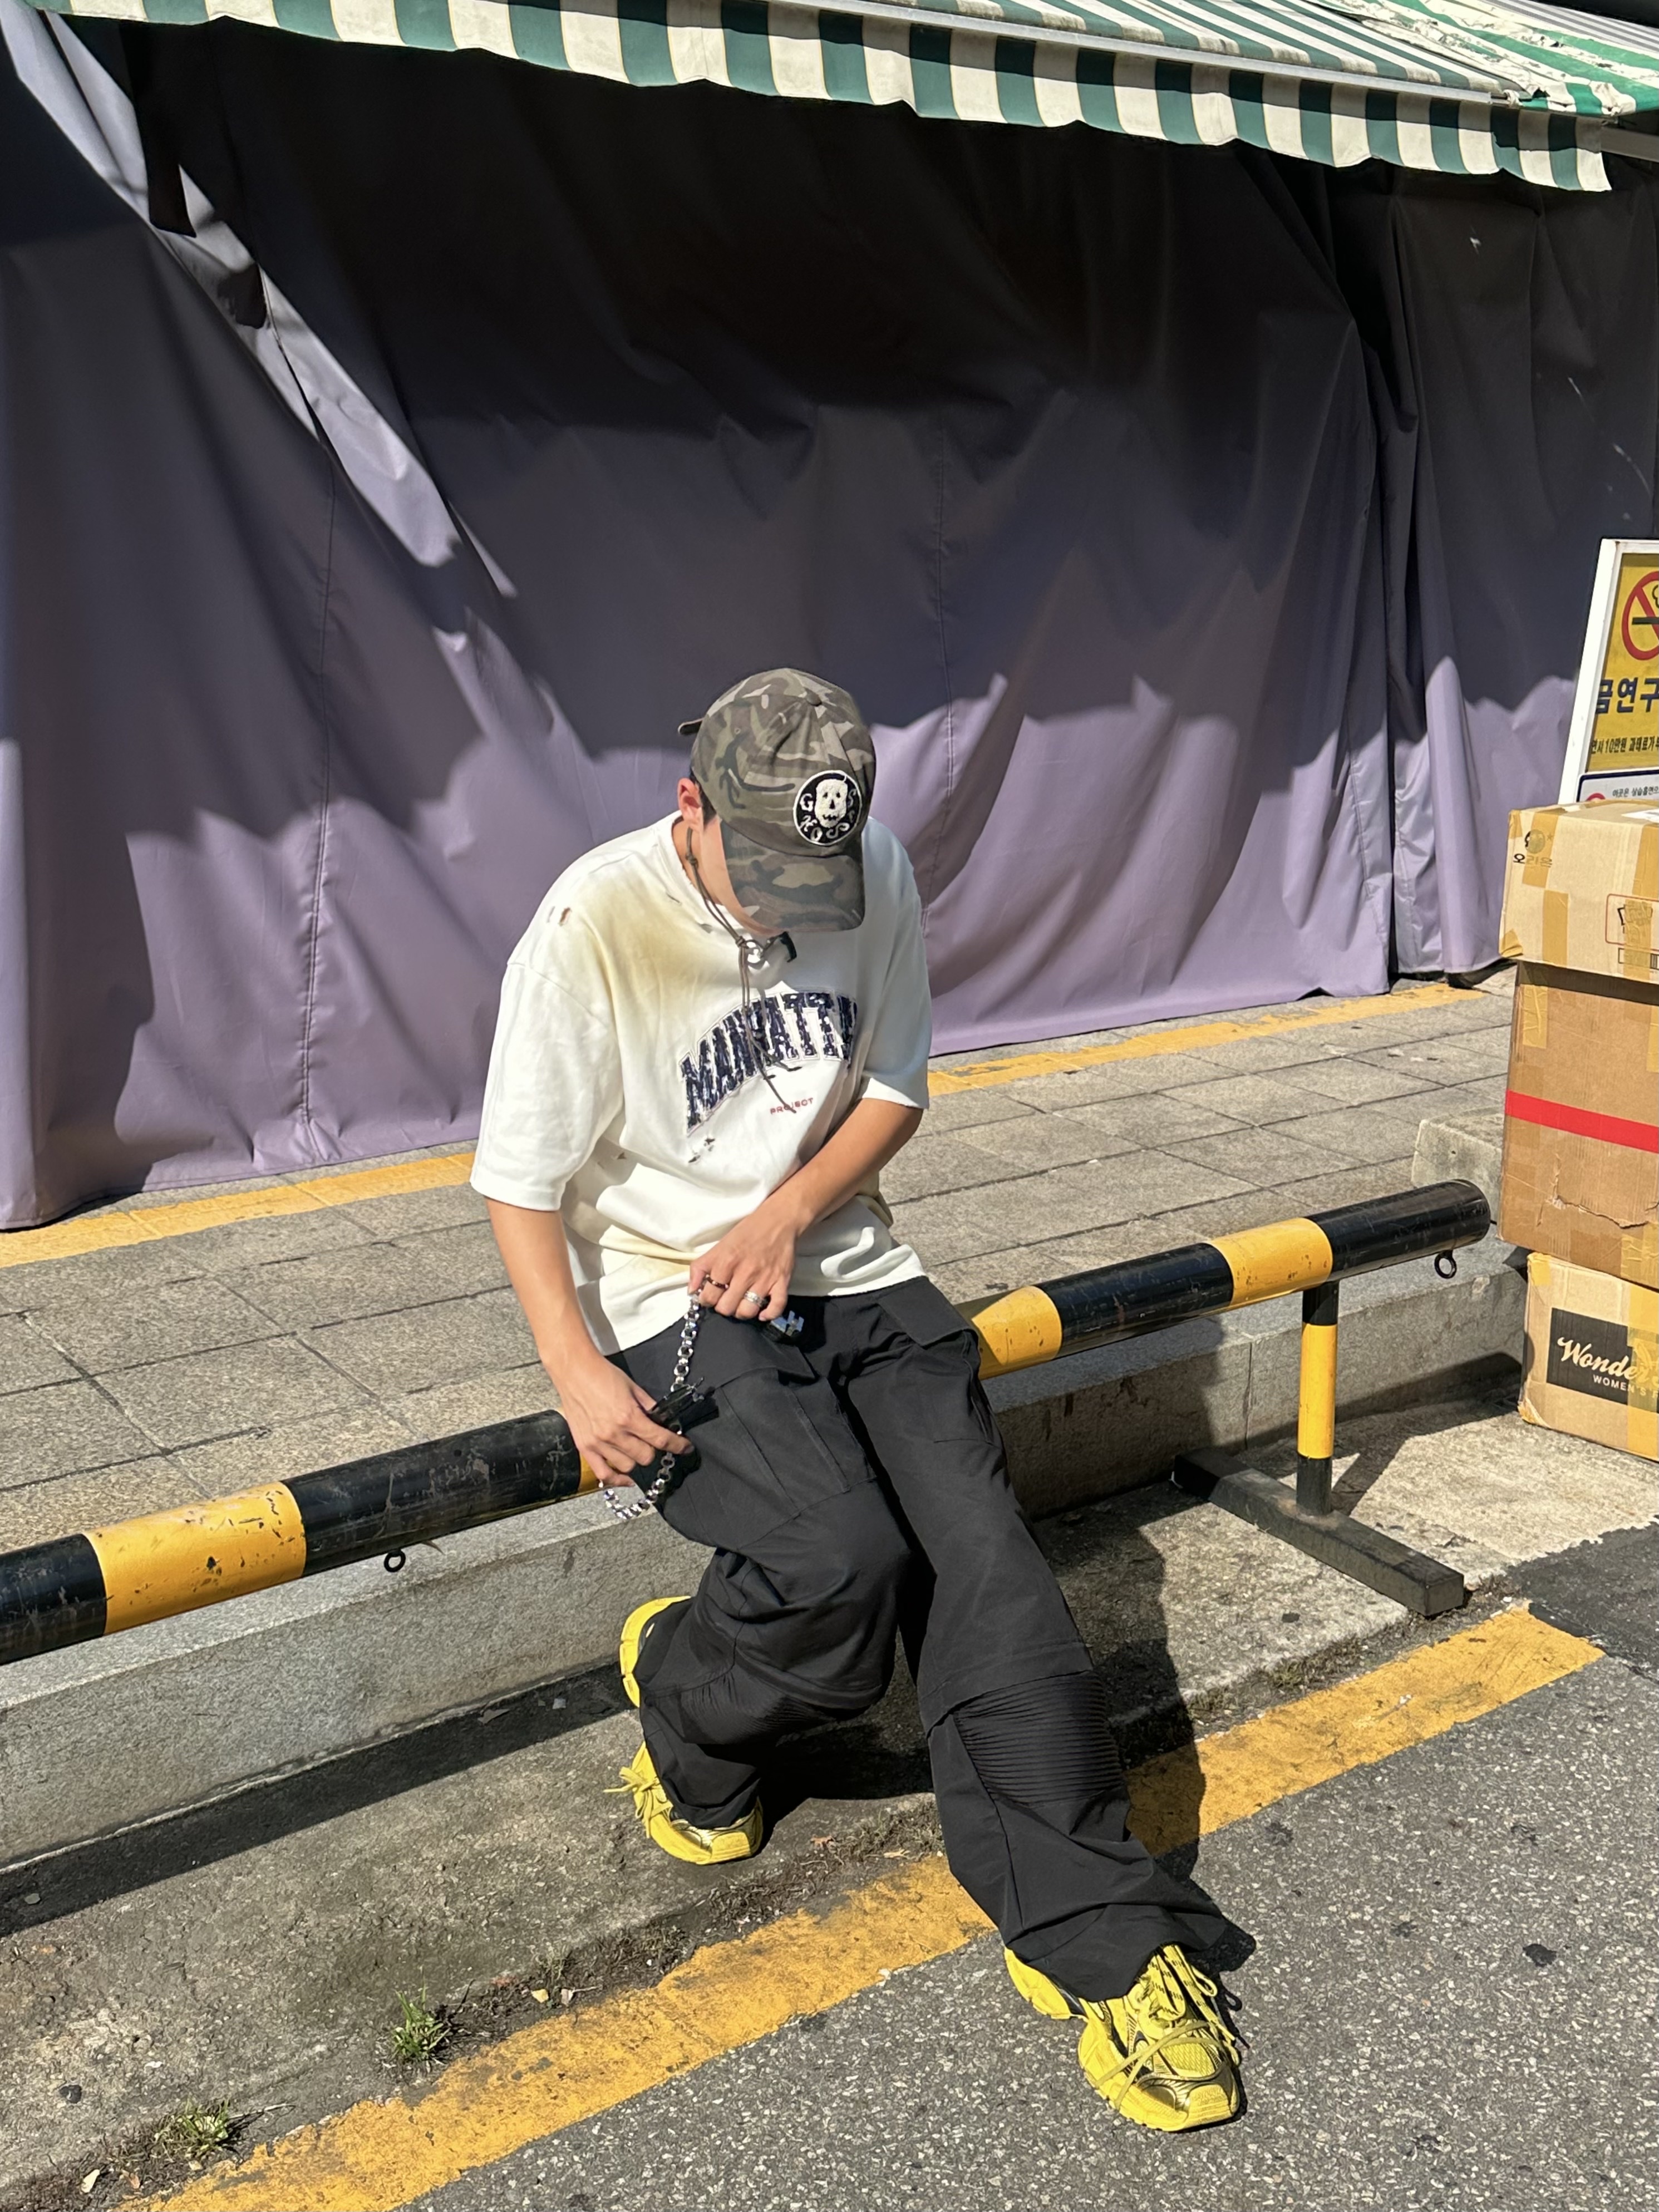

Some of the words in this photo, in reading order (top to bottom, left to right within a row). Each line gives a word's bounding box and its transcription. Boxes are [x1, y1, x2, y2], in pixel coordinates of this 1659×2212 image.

[1612, 787, 1630, 798] 이곳은
[1513, 853, 1553, 868] 오리온
[770, 1097, 814, 1115] PROJECT
[1593, 1374, 1647, 1397] WOMEN'S
